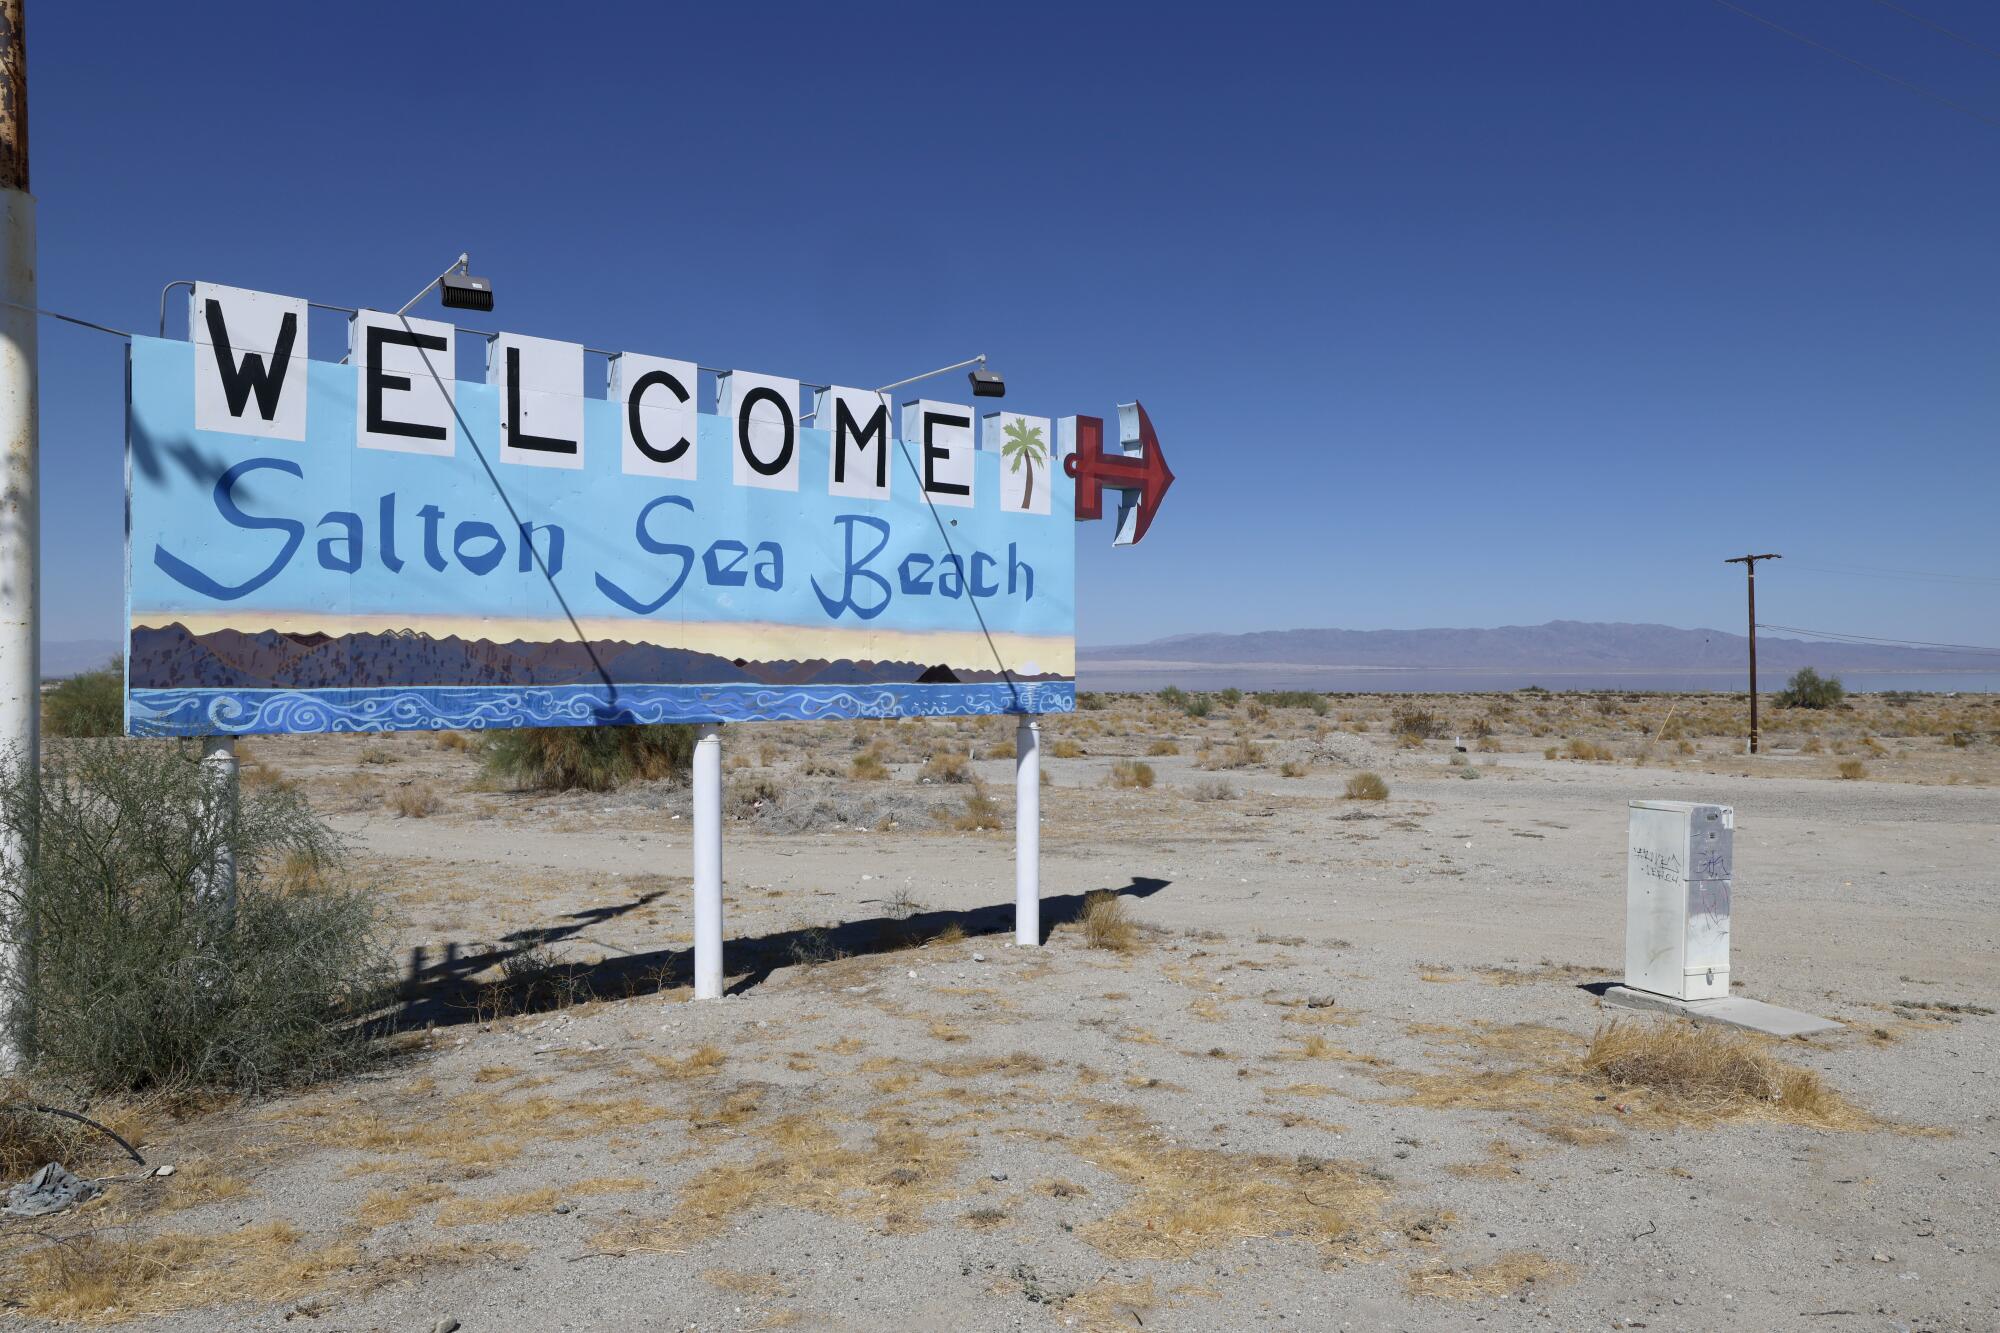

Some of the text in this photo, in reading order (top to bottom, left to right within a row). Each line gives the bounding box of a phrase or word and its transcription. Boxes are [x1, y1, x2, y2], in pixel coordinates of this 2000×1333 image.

[205, 299, 970, 496] WELCOME
[154, 457, 1034, 619] Salton Sea Beach
